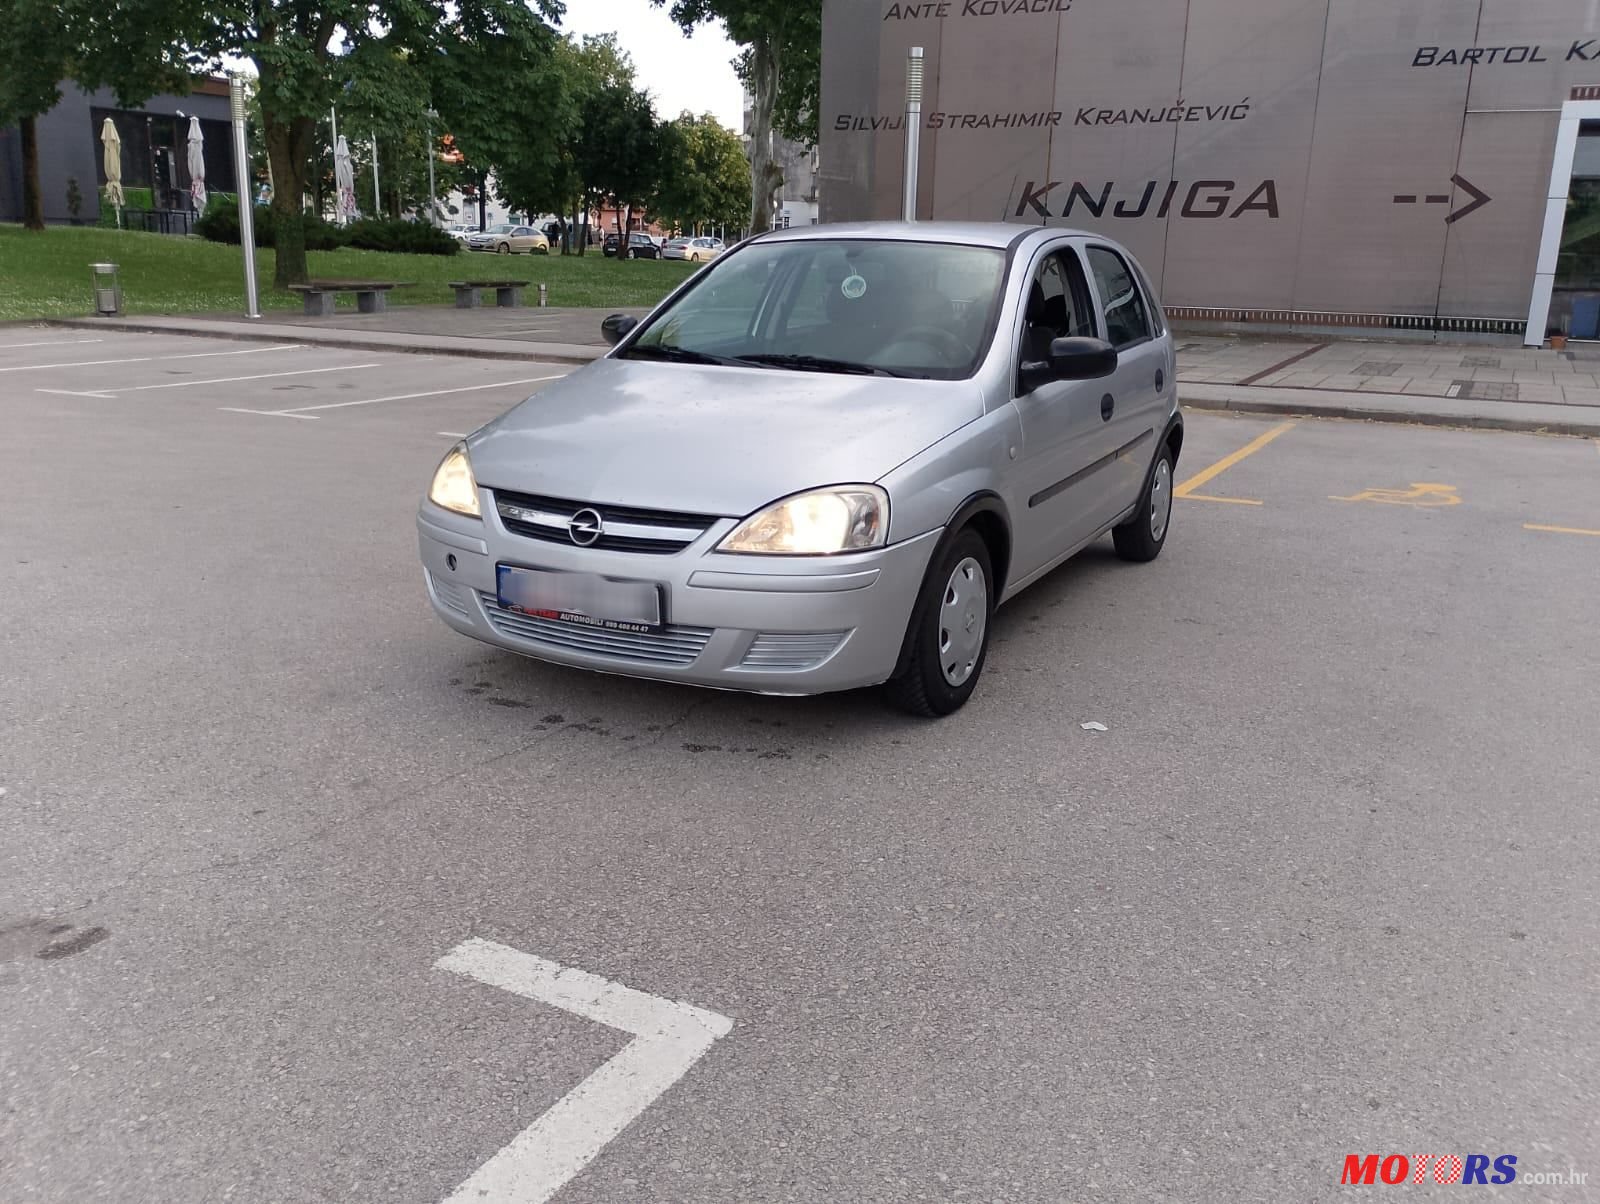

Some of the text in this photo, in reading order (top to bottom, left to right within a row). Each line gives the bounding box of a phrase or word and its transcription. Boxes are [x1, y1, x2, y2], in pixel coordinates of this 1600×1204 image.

[883, 3, 952, 21] ANTE
[1411, 45, 1547, 67] BARTOL
[833, 97, 1250, 131] SILVIJ STRAHIMIR KRANJČEVIĆ
[1014, 179, 1279, 218] KNJIGA
